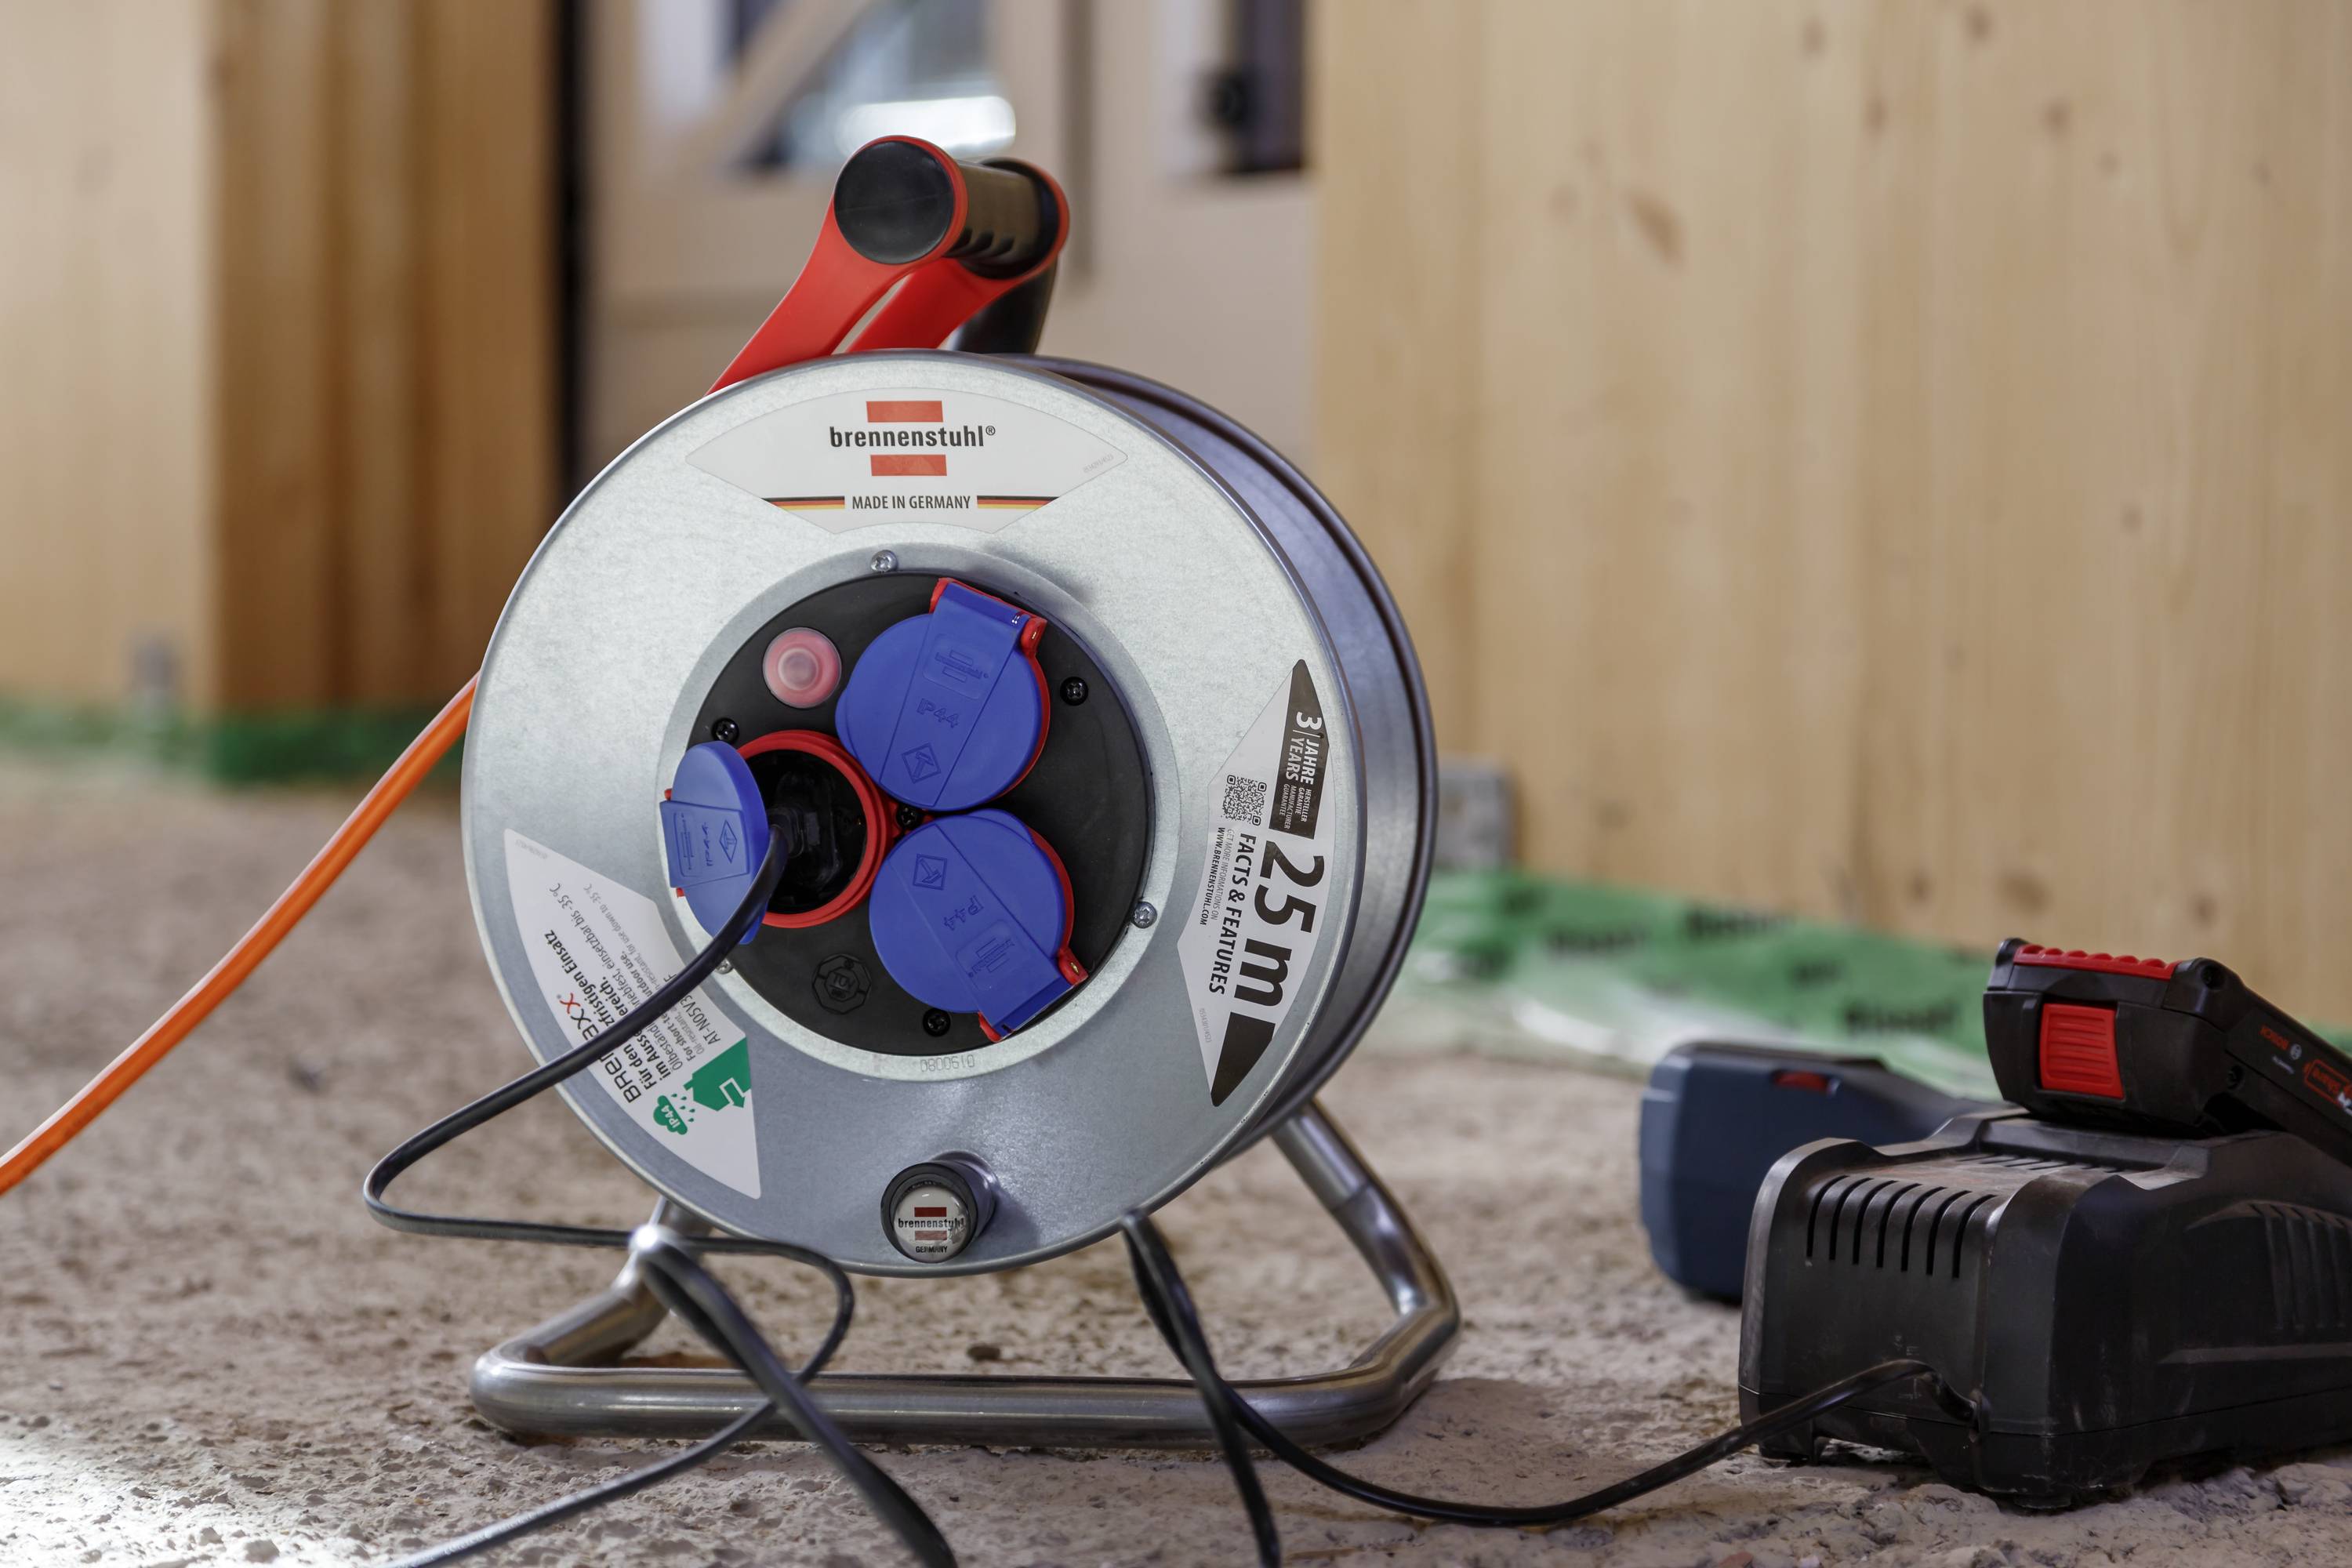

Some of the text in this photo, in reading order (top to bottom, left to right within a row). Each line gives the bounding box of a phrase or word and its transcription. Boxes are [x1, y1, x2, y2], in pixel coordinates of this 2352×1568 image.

[852, 495, 971, 510] MADE IN GERMANY
[1297, 712, 1322, 729] 3
[1286, 739, 1305, 780] YEARS
[1301, 739, 1319, 784] JAHRE
[1279, 784, 1289, 815] GUARANTEE
[1284, 786, 1297, 829] MANUFACTURER
[1295, 788, 1305, 814] GARANTIE
[1301, 789, 1312, 822] HERSTELLER
[1222, 842, 1232, 861] MORE
[1200, 828, 1225, 925] WWW.BRENNENSTUHL.COM
[1213, 862, 1228, 909] INFORMATIONS
[549, 883, 559, 896] °C
[557, 895, 572, 909] -35
[601, 905, 607, 913] to
[1209, 833, 1256, 994] FACTS & FEATURES
[571, 911, 584, 927] bis
[605, 912, 620, 930] down
[1210, 910, 1218, 920] ON
[1234, 840, 1324, 1006] 25 m
[580, 924, 615, 967] einsetzbar
[619, 931, 629, 944] use
[620, 951, 633, 969] use.
[544, 930, 657, 1090] Für den zfristigen Einsatz
[600, 977, 671, 1079] im Ausseereich.
[683, 1046, 696, 1062] For
[660, 1105, 681, 1127] IP44
